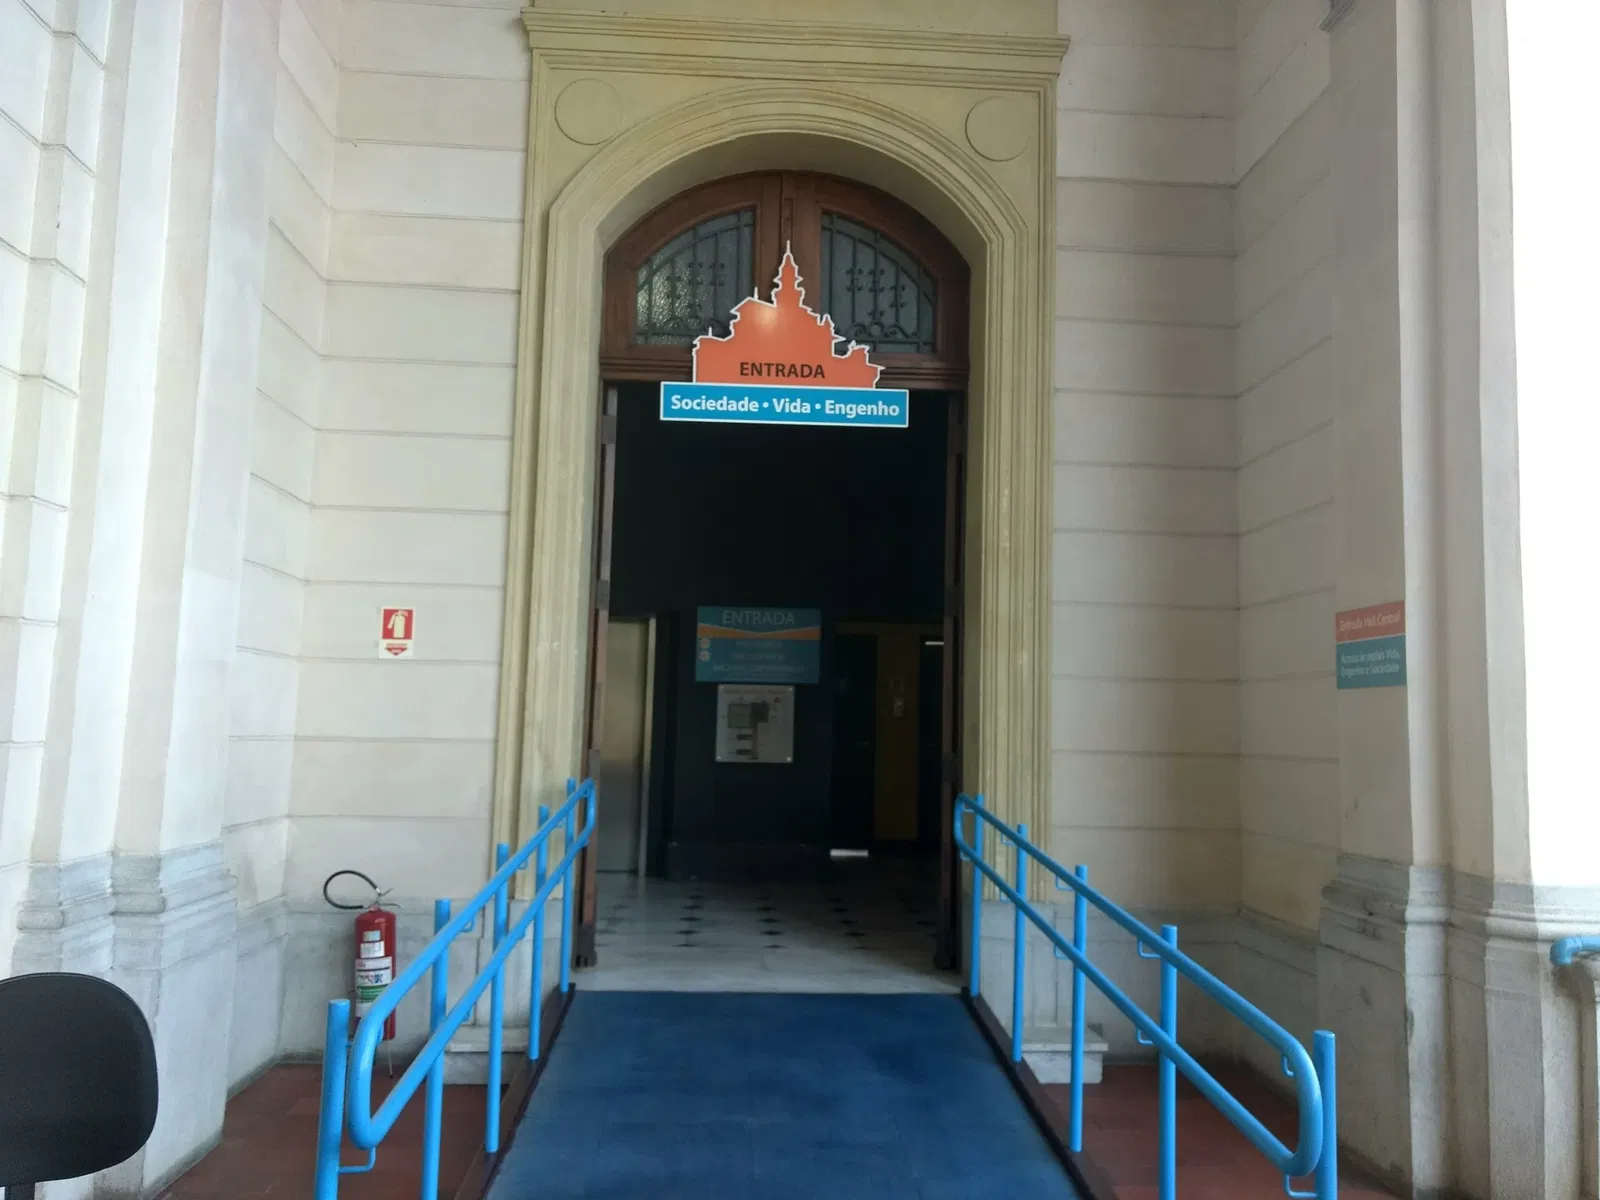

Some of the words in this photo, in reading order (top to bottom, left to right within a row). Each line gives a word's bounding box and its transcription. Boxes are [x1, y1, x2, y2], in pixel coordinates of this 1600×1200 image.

[739, 361, 825, 379] ENTRADA
[670, 395, 760, 413] Sociedade
[773, 398, 811, 414] Vida
[825, 400, 900, 418] Engenho
[722, 610, 795, 625] ENTRADA
[1340, 616, 1364, 631] Entrada
[1364, 614, 1377, 628] Hall
[1377, 610, 1400, 625] Central
